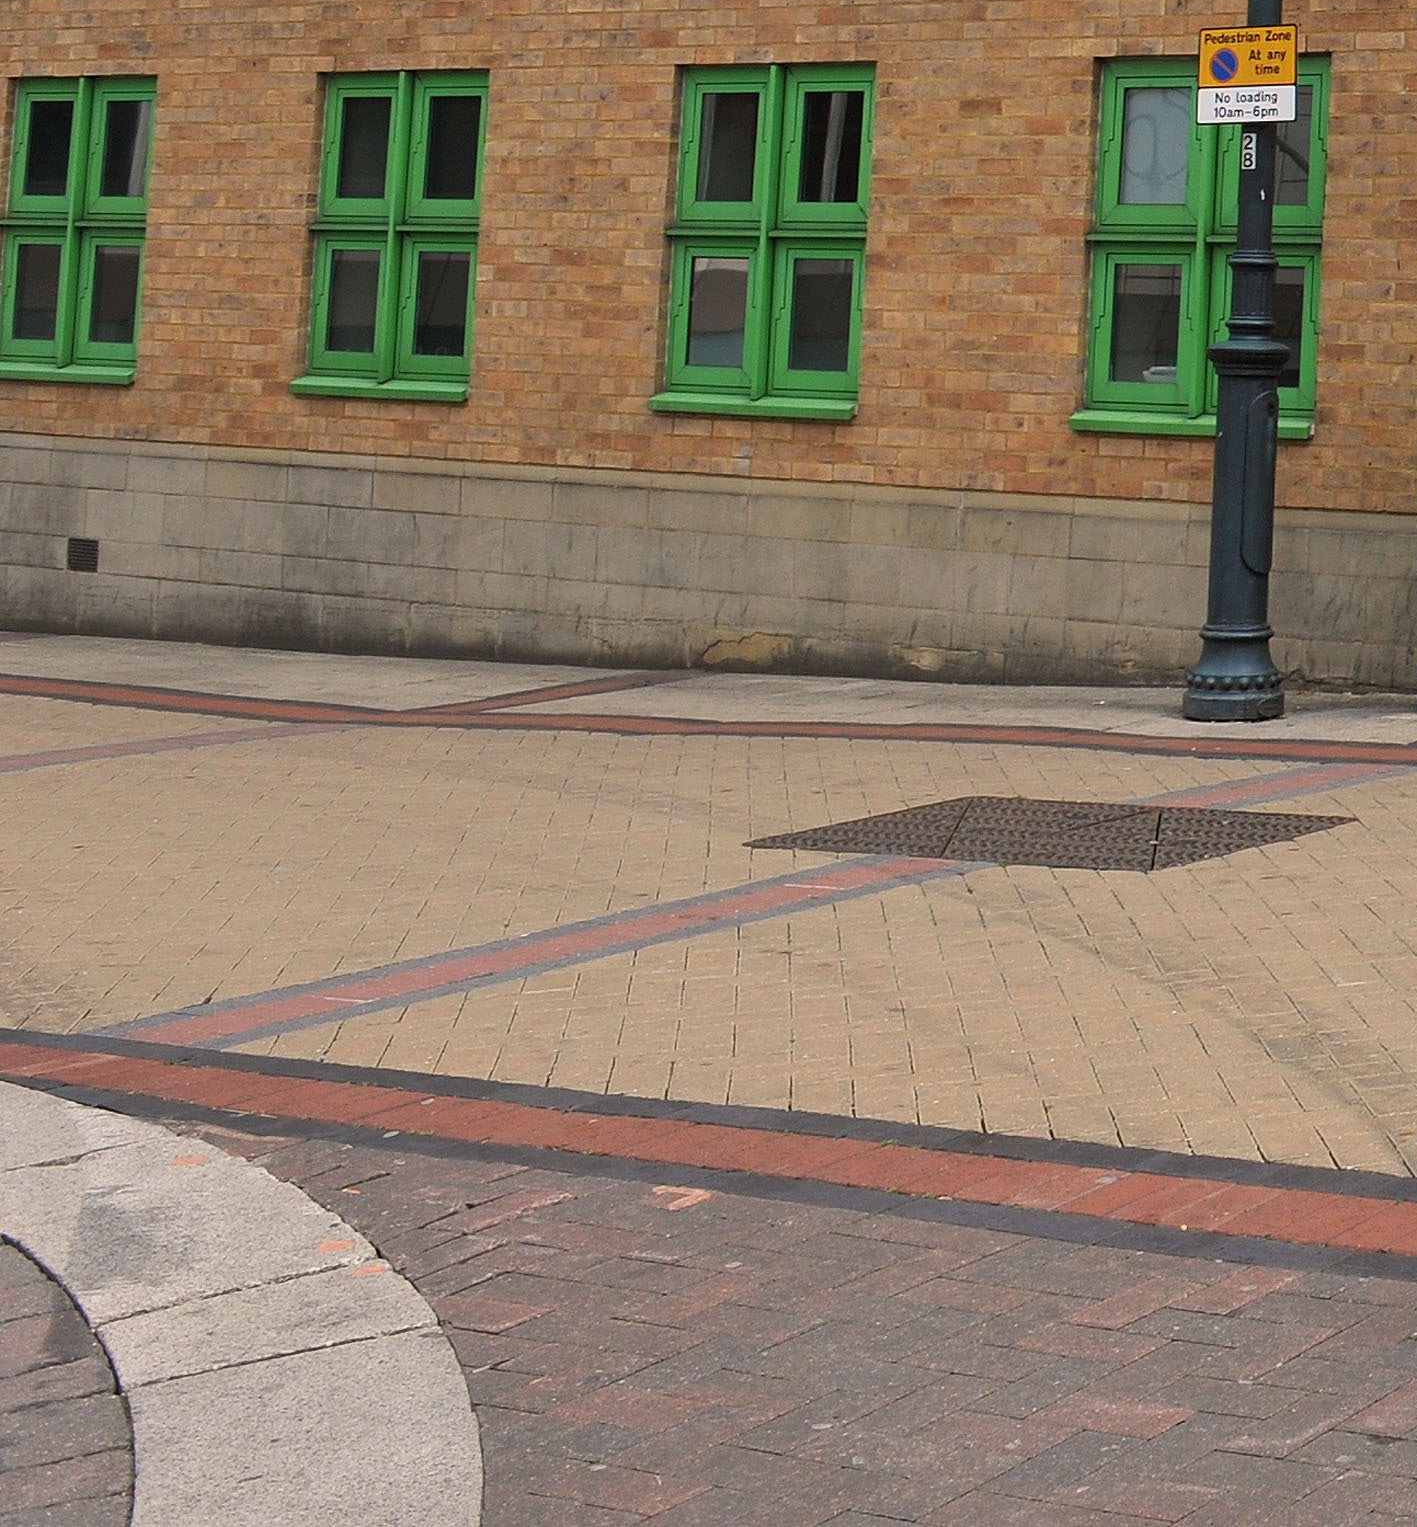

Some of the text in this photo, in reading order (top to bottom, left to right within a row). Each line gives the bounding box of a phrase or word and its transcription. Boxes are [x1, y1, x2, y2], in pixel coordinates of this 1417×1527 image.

[1204, 30, 1292, 45] Pedestrian Zone
[1248, 49, 1287, 62] At any
[1255, 64, 1280, 75] time
[1214, 91, 1278, 104] No loading
